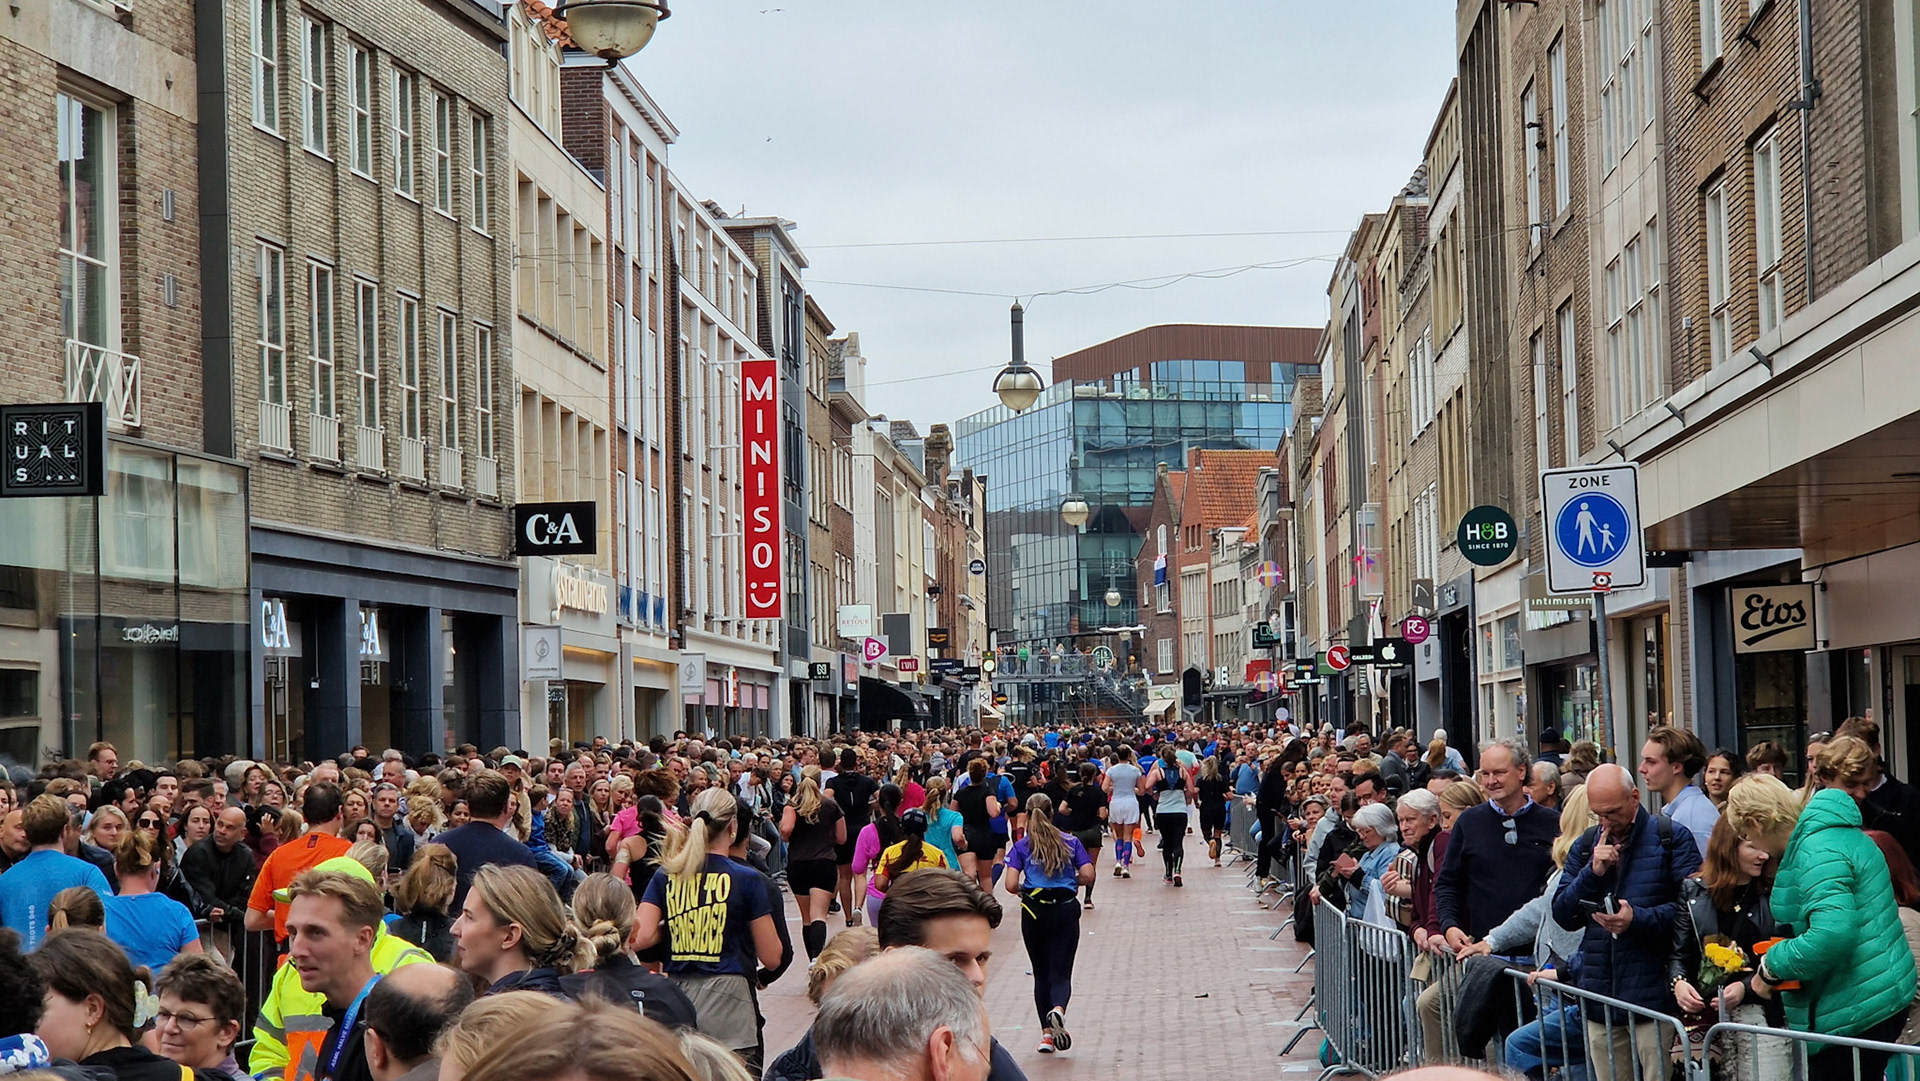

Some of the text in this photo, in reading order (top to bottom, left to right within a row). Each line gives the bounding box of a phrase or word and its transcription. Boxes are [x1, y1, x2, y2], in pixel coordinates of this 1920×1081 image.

[746, 376, 774, 569] MINISO
[1568, 475, 1611, 489] ZONE
[525, 512, 583, 546] C&A
[1466, 521, 1509, 541] H&B
[261, 600, 292, 649] C&A
[1740, 593, 1807, 631] Etos
[666, 872, 731, 920] RUN TO
